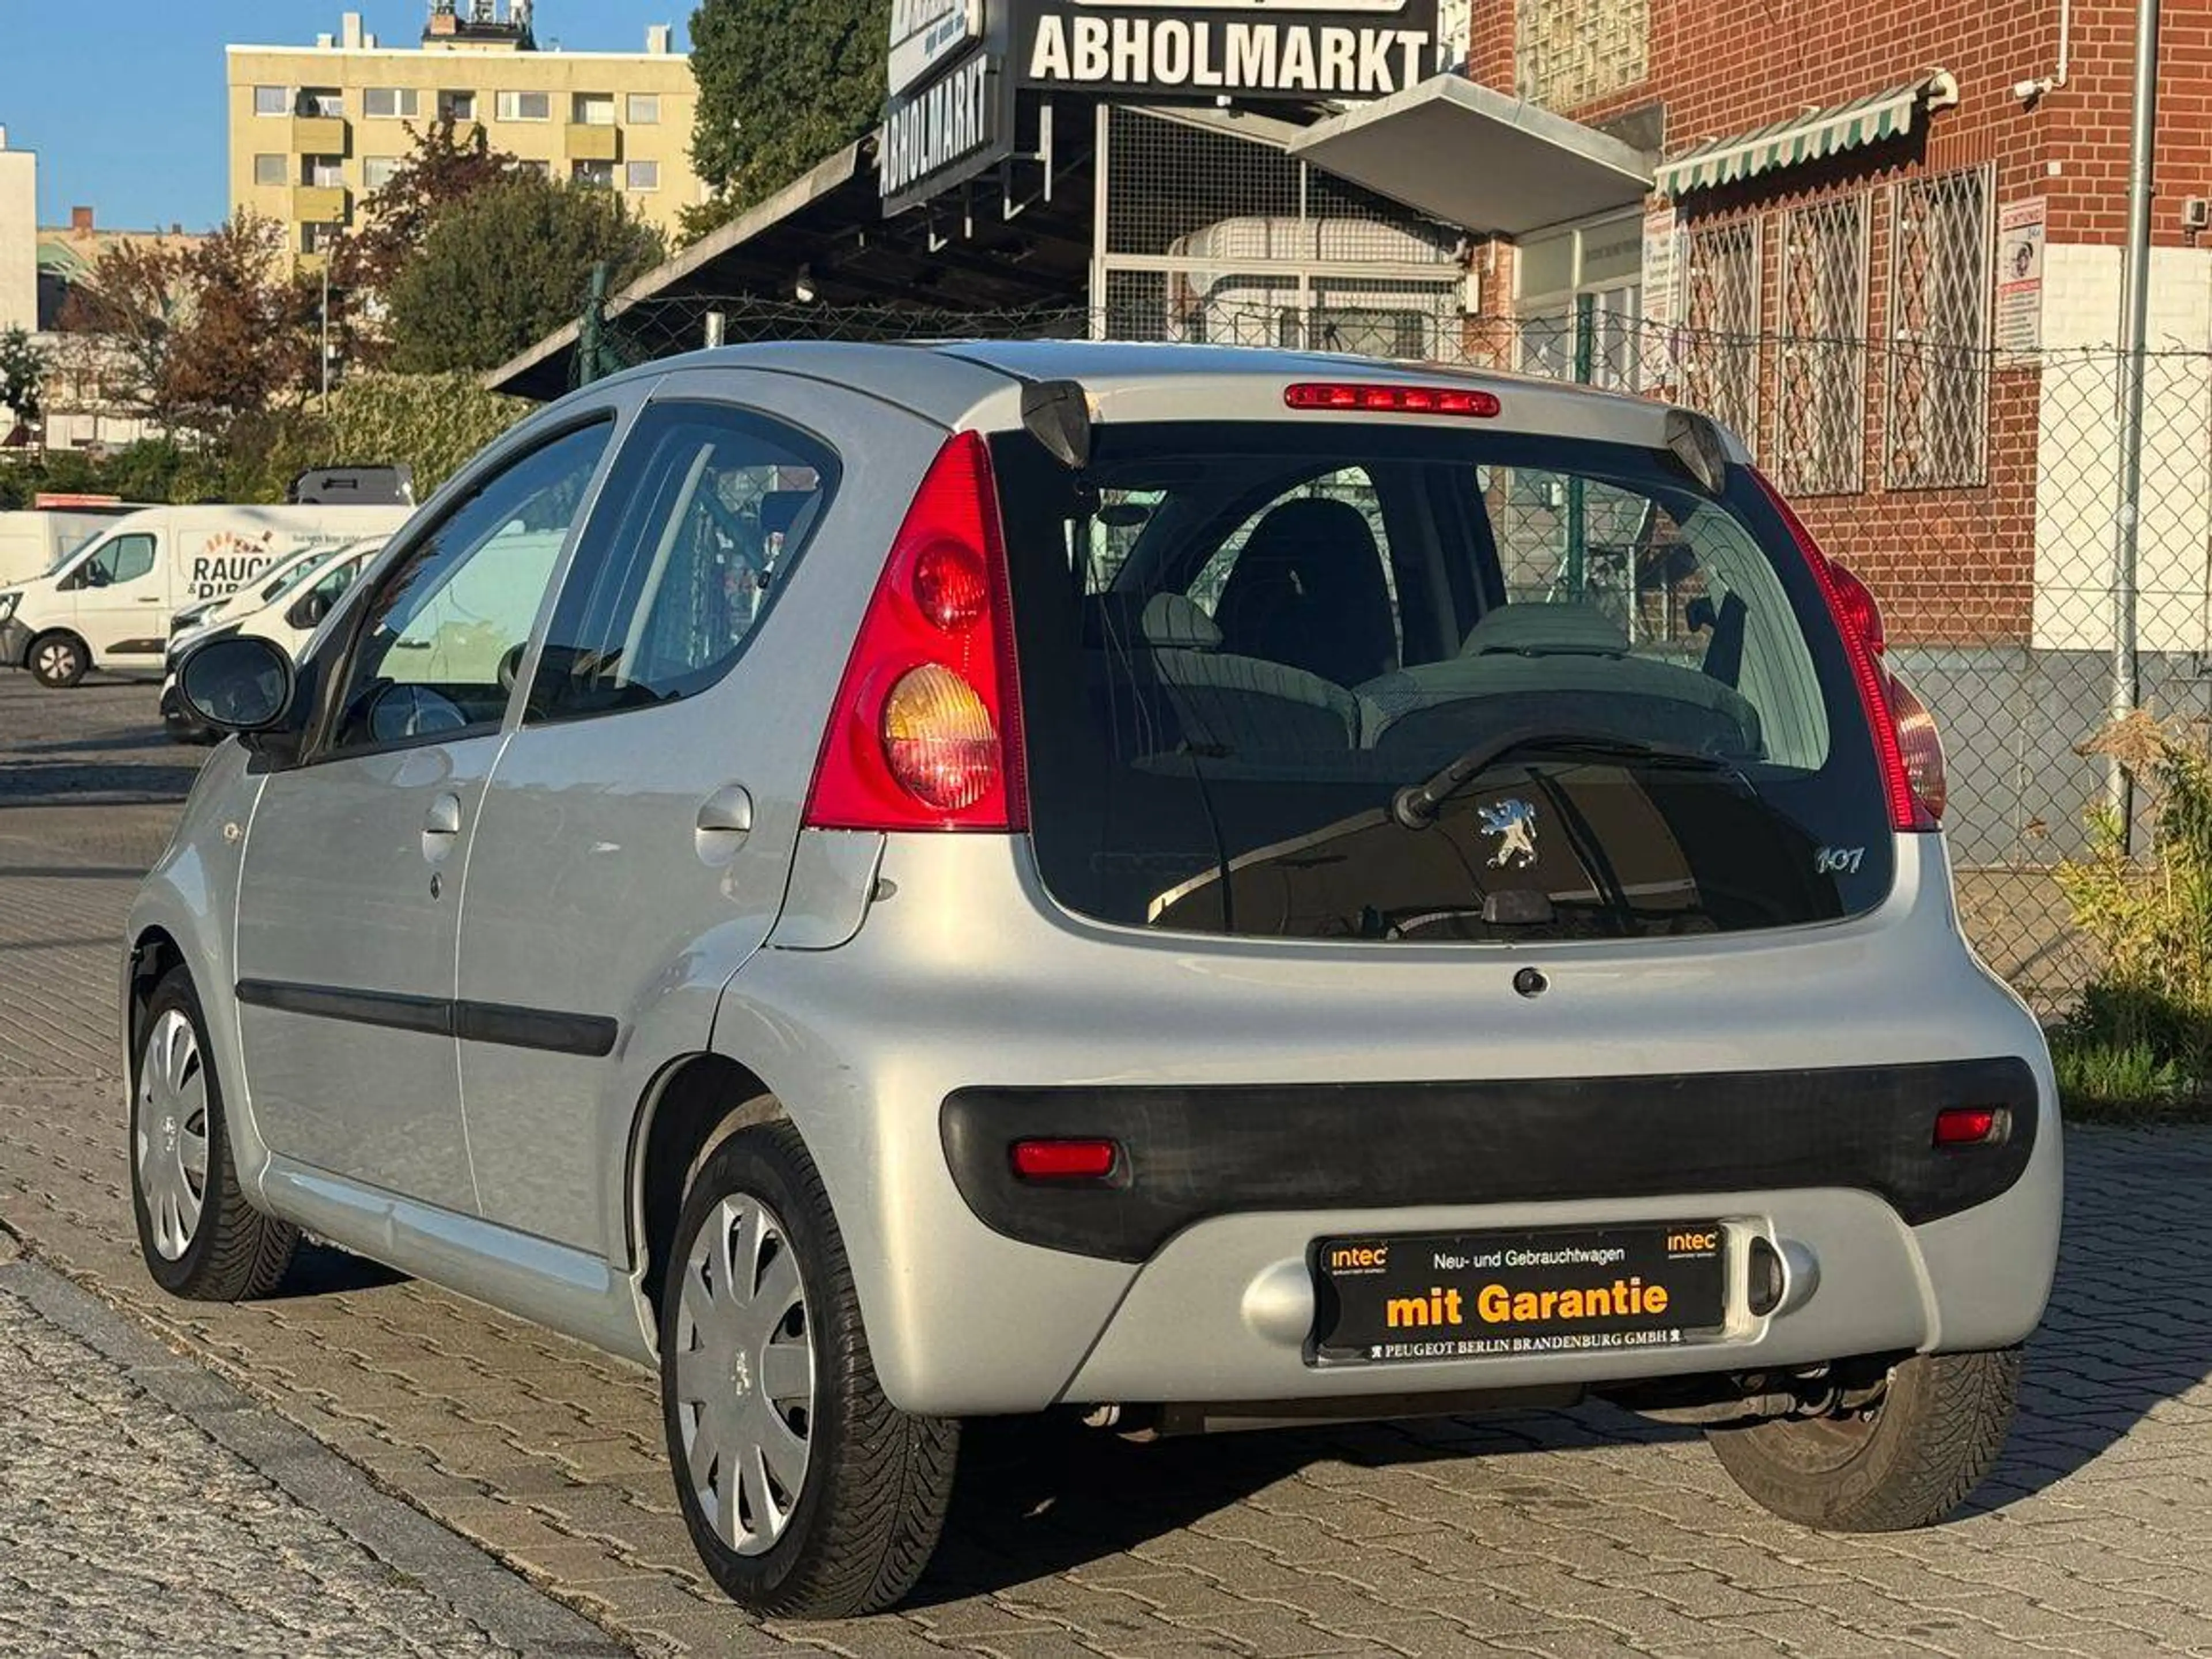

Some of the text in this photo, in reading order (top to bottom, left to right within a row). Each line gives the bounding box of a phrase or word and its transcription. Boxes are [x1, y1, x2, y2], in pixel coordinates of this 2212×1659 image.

[1029, 14, 1429, 93] ABHOLMARKT
[880, 54, 987, 198] ABHOLMARKT
[194, 557, 271, 582] RAUC
[1817, 847, 1865, 874] 107
[1668, 1233, 1717, 1251] intec
[1331, 1247, 1387, 1267] intec
[1434, 1247, 1625, 1270] Neu- und Gebrauchtwagen
[1387, 1277, 1668, 1327] mit Garantie
[1385, 1330, 1667, 1357] PEUGEOT BERLIN BRANDENBURG GMBH
